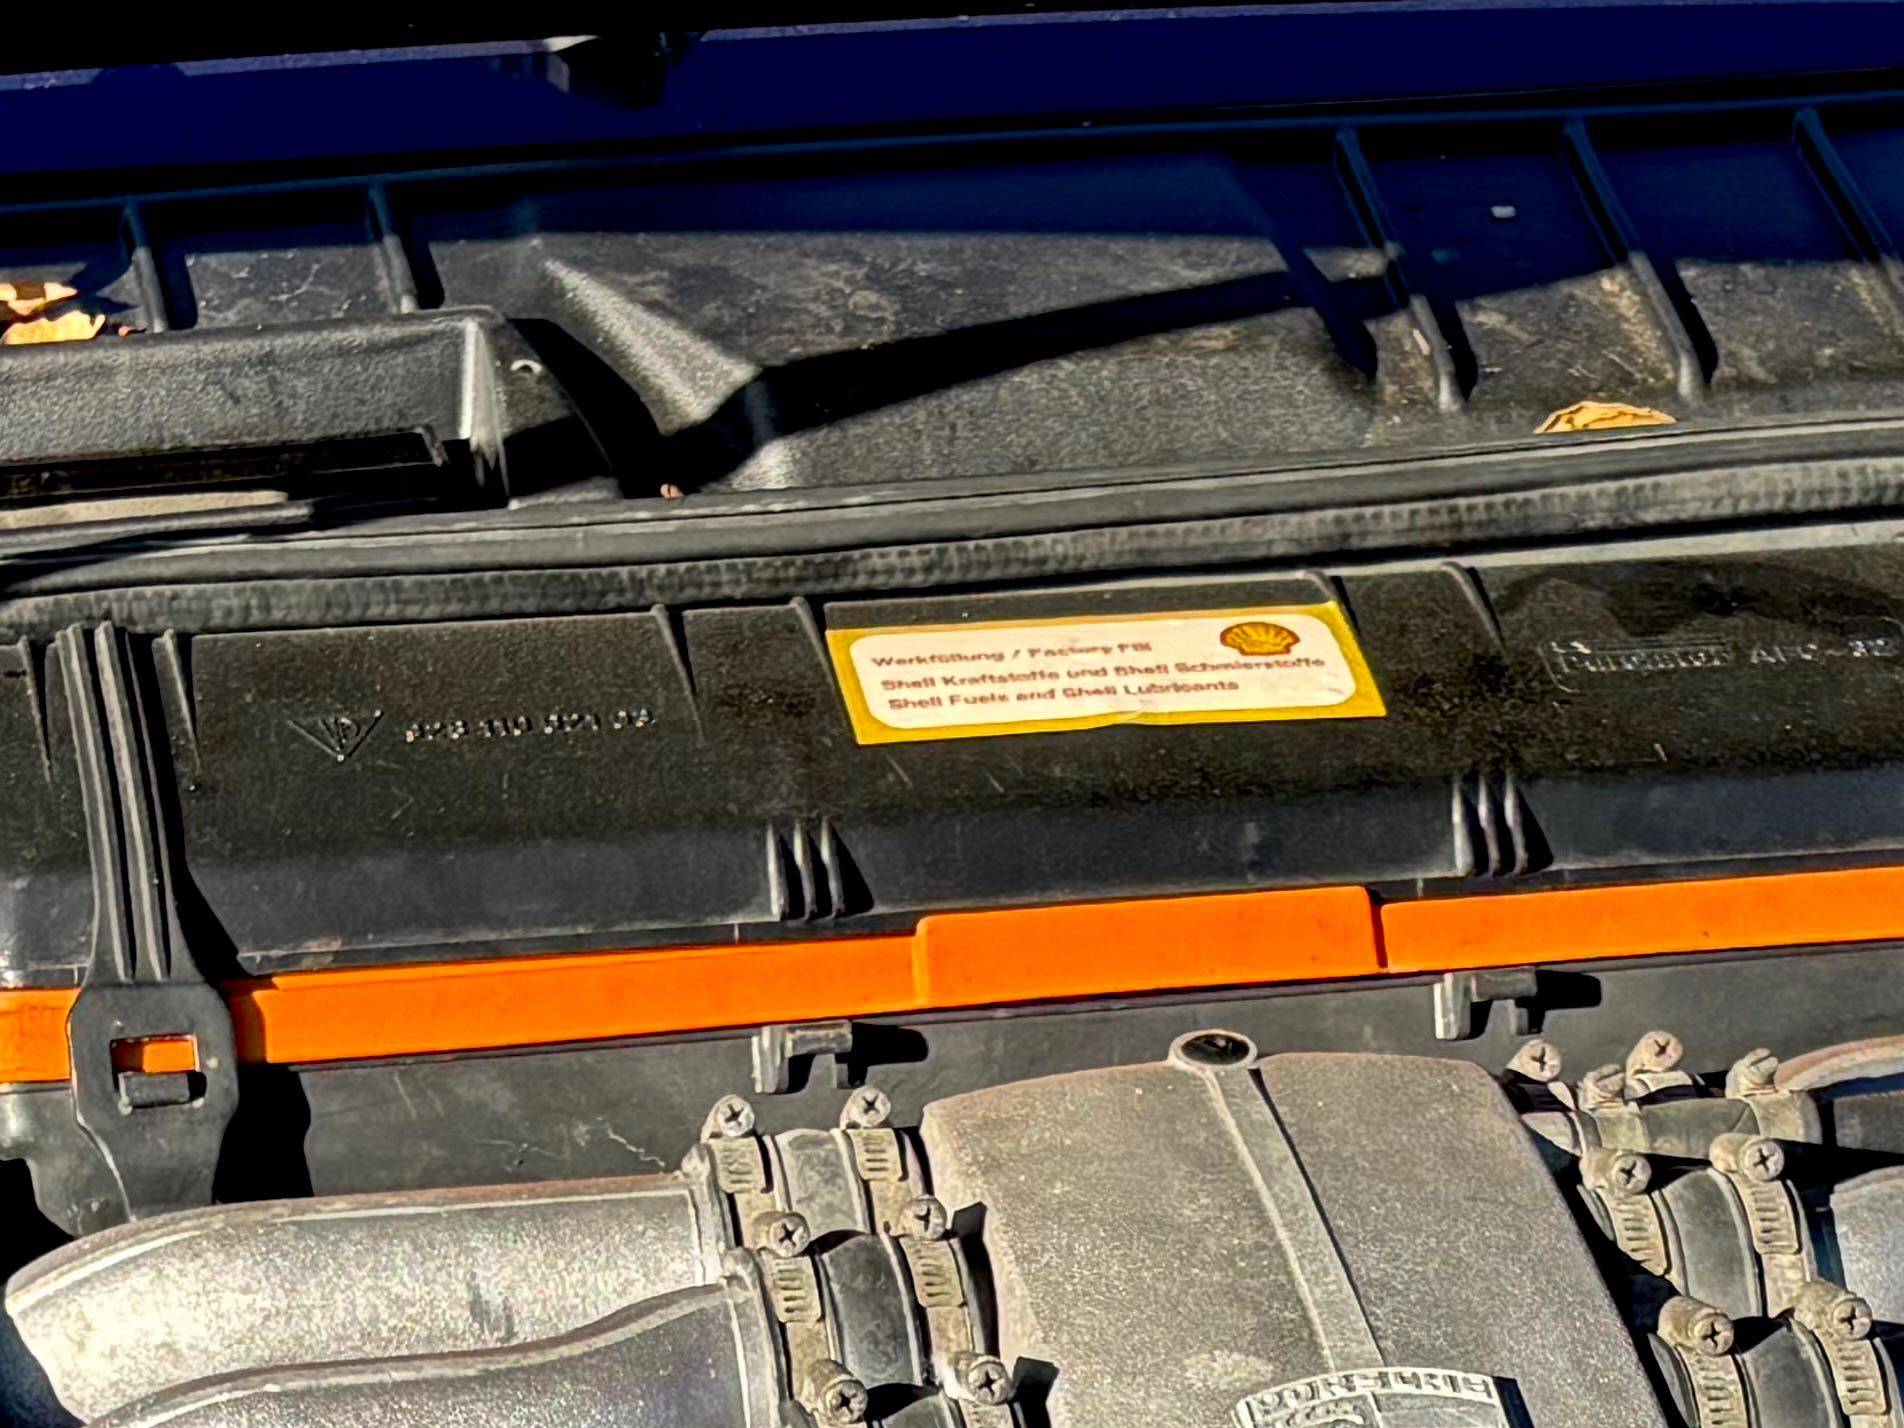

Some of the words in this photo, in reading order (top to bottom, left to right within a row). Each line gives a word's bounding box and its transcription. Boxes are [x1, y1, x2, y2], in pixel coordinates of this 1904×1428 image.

[881, 674, 937, 692] Shell
[941, 668, 1059, 688] Kraftstoffe
[1065, 665, 1109, 680] und
[1113, 662, 1170, 678] Shell
[1174, 656, 1327, 676] Schmierstoffe
[888, 694, 944, 712] Shell
[948, 690, 1010, 708] Fuels
[1015, 687, 1058, 704] and
[1062, 684, 1120, 701] Shell
[1123, 679, 1241, 699] Lubricants
